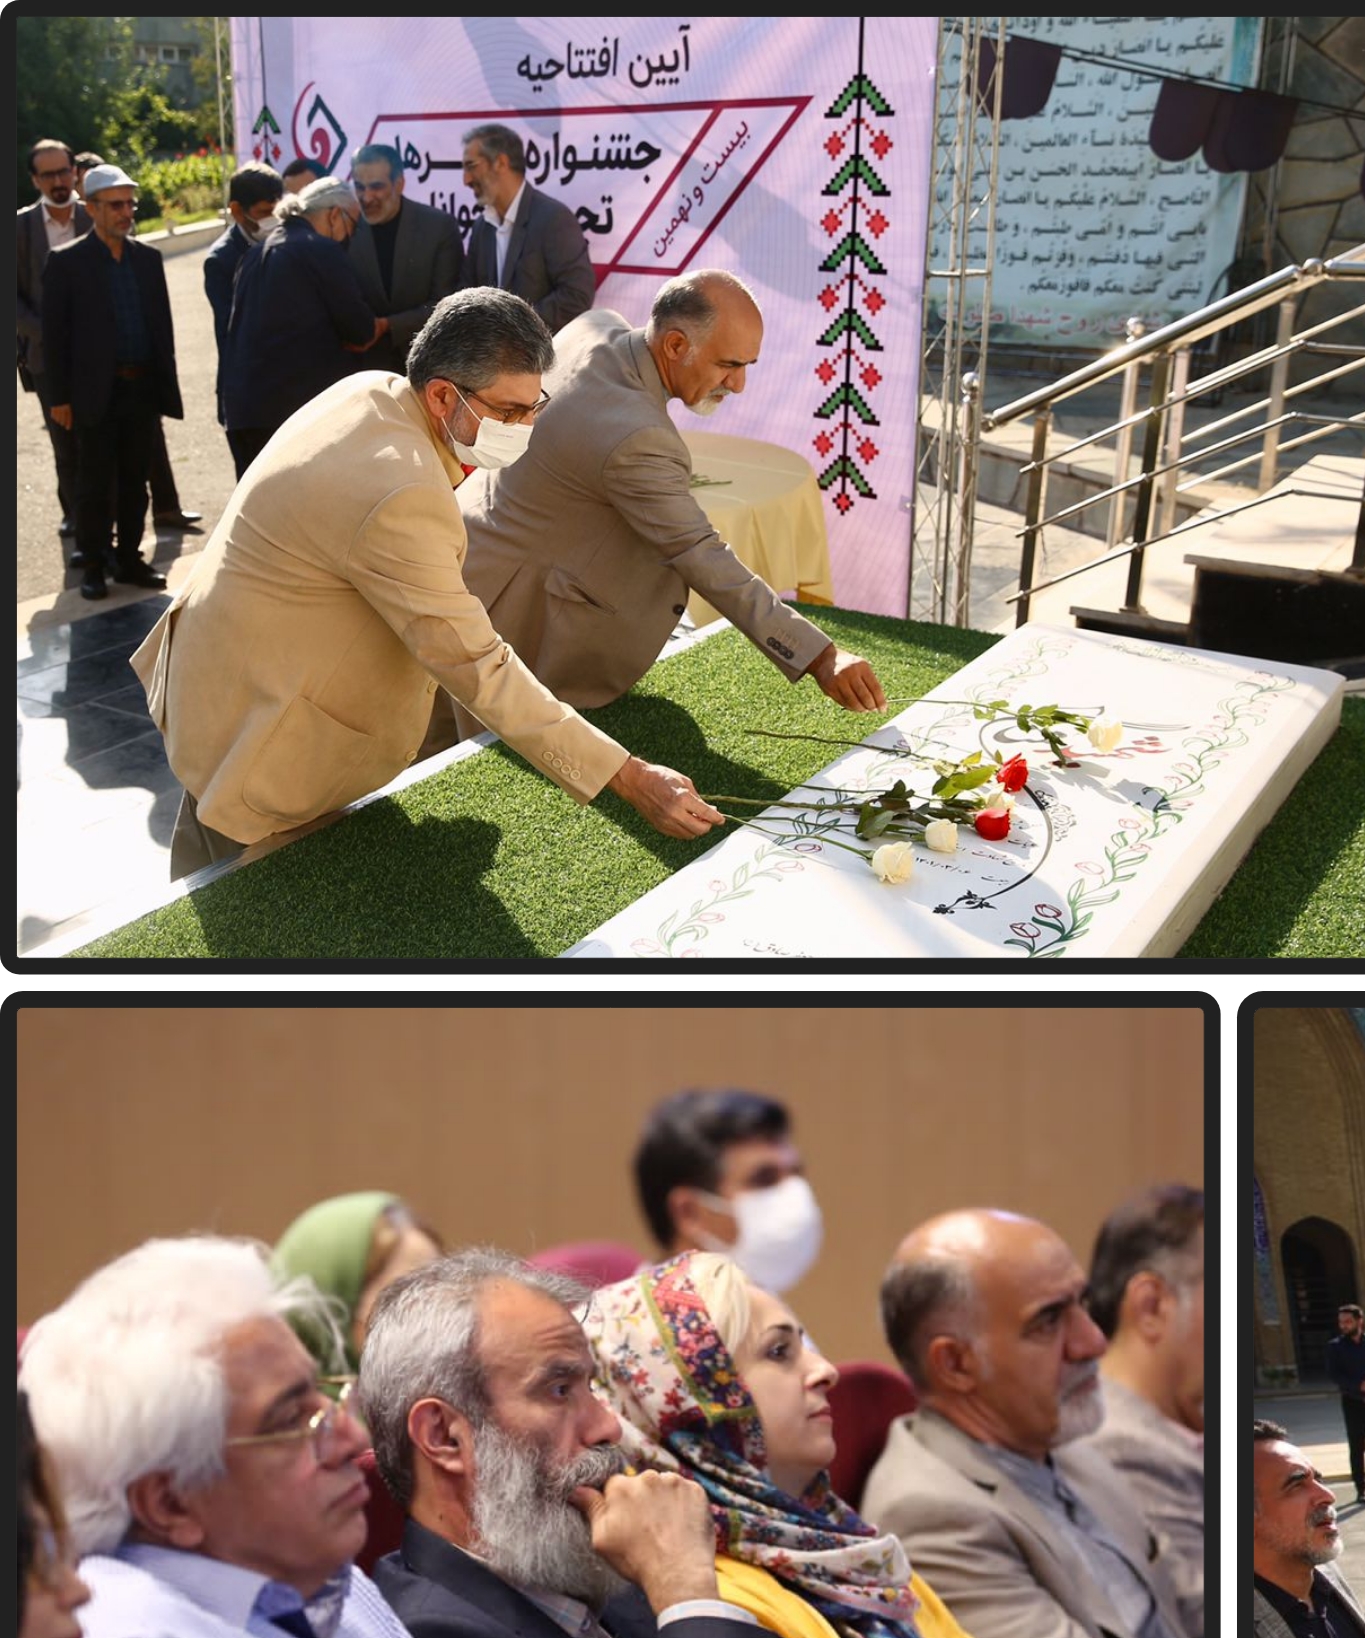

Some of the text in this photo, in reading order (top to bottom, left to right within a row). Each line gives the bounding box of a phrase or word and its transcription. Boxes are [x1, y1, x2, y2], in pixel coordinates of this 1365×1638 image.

[516, 24, 690, 94] آیین افتتاحیه
[524, 132, 662, 186] جشنواره
